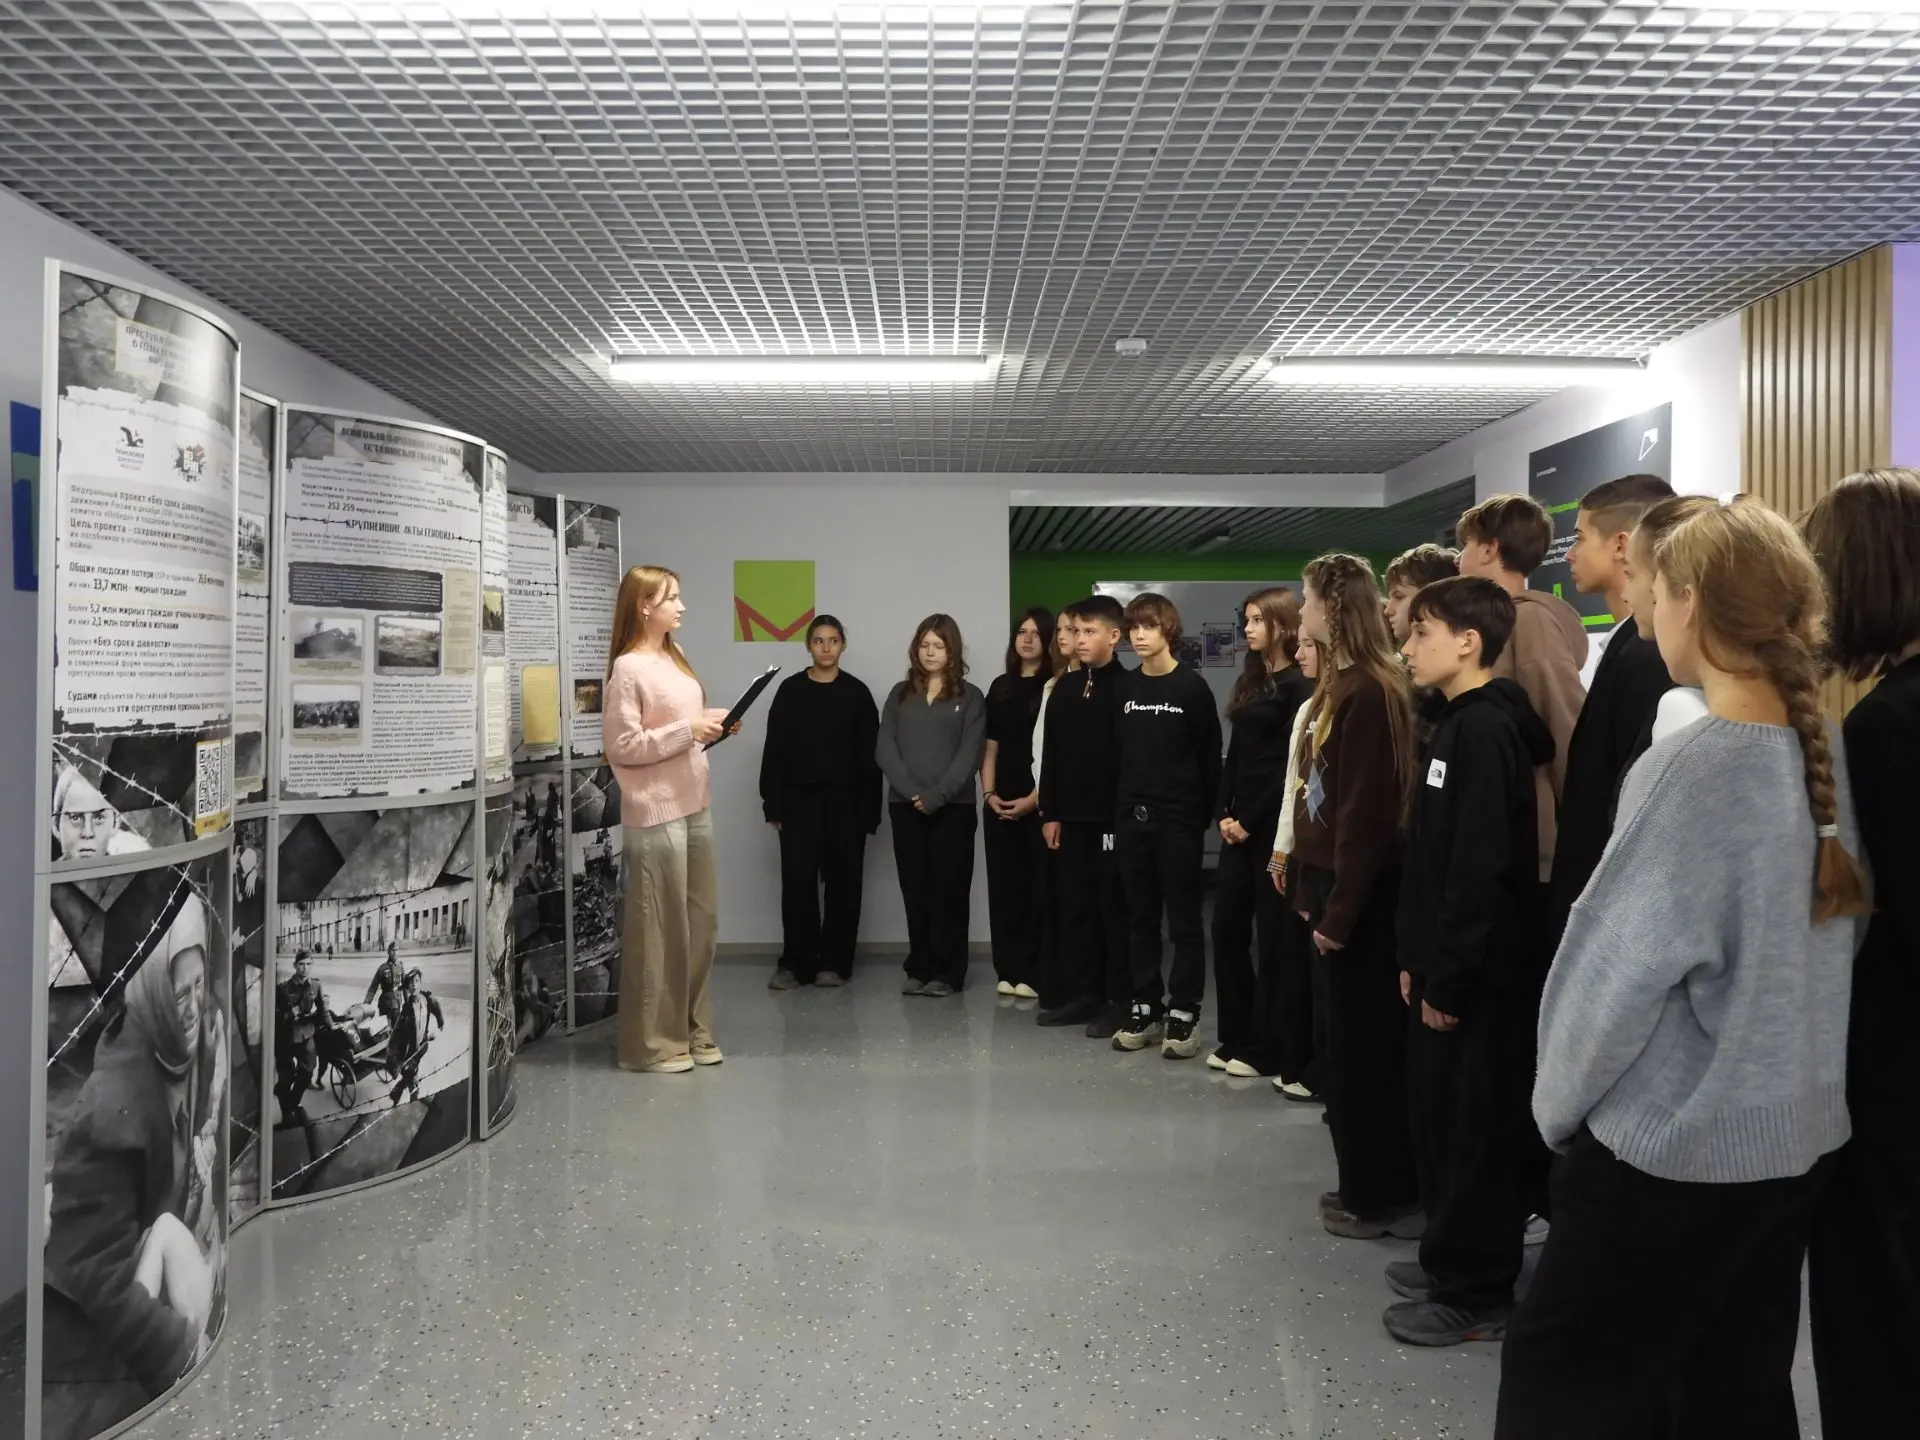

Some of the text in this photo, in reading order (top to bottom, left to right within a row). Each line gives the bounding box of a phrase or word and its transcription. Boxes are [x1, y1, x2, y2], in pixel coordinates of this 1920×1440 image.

[70, 517, 93, 530] Цель
[94, 521, 127, 534] проекта
[345, 519, 401, 534] КРУПНЕЙШИЕ
[402, 525, 424, 537] АКТЫ
[69, 562, 96, 573] Общие
[97, 567, 130, 577] людские
[131, 569, 154, 580] потери
[93, 577, 109, 592] 13,7
[110, 582, 128, 592] млн
[90, 602, 101, 614] 5,2
[102, 606, 117, 614] млн
[118, 607, 145, 617] мирных
[147, 608, 173, 619] граждан
[103, 619, 118, 628] млн
[119, 618, 147, 629] погибли
[93, 636, 111, 646] «Без
[113, 639, 135, 648] срока
[68, 690, 98, 702] Судами
[117, 704, 130, 713] эти
[131, 703, 177, 713] преступления
[1124, 701, 1184, 715] Champion
